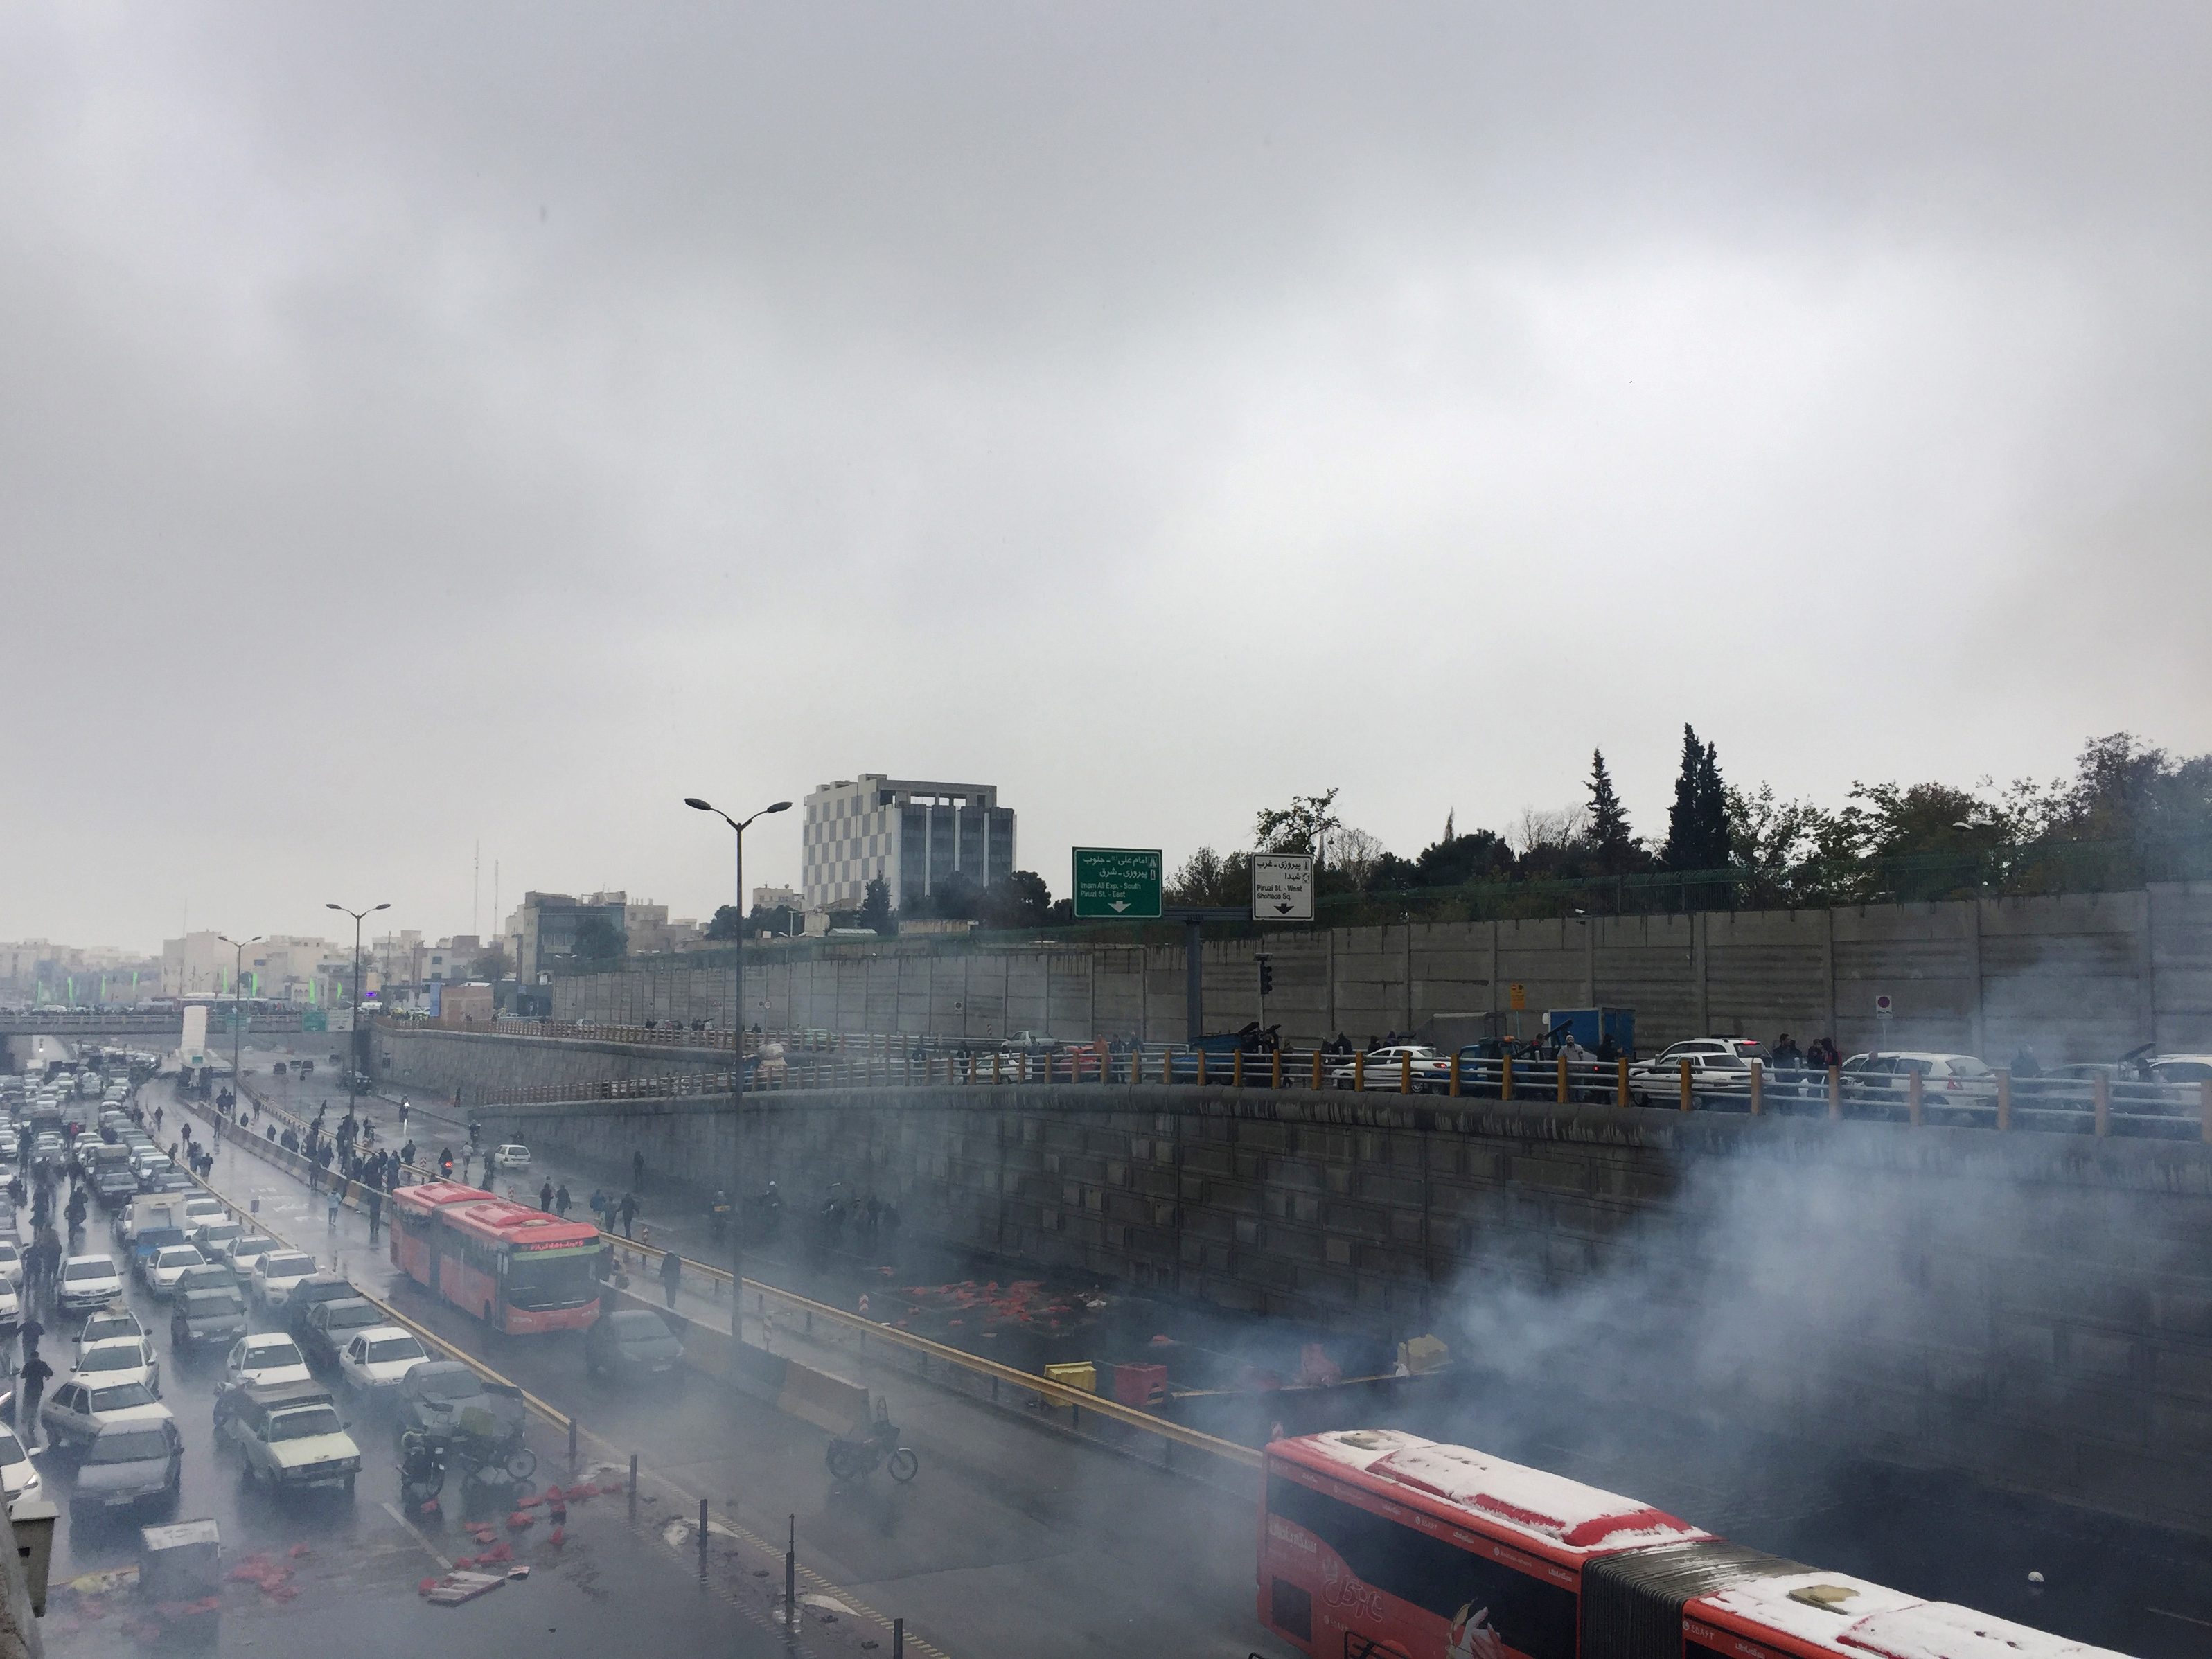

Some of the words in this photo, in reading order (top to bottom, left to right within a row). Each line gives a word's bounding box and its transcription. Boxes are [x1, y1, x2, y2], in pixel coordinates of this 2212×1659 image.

[1083, 856, 1105, 865] جنوب
[1118, 856, 1132, 865] علی
[1133, 857, 1147, 867] امام
[1257, 860, 1272, 869] غرب
[1279, 861, 1301, 871] پیروزی
[1099, 867, 1117, 877] شرق
[1123, 869, 1147, 879] پیروزی
[1284, 873, 1300, 881] شهدا
